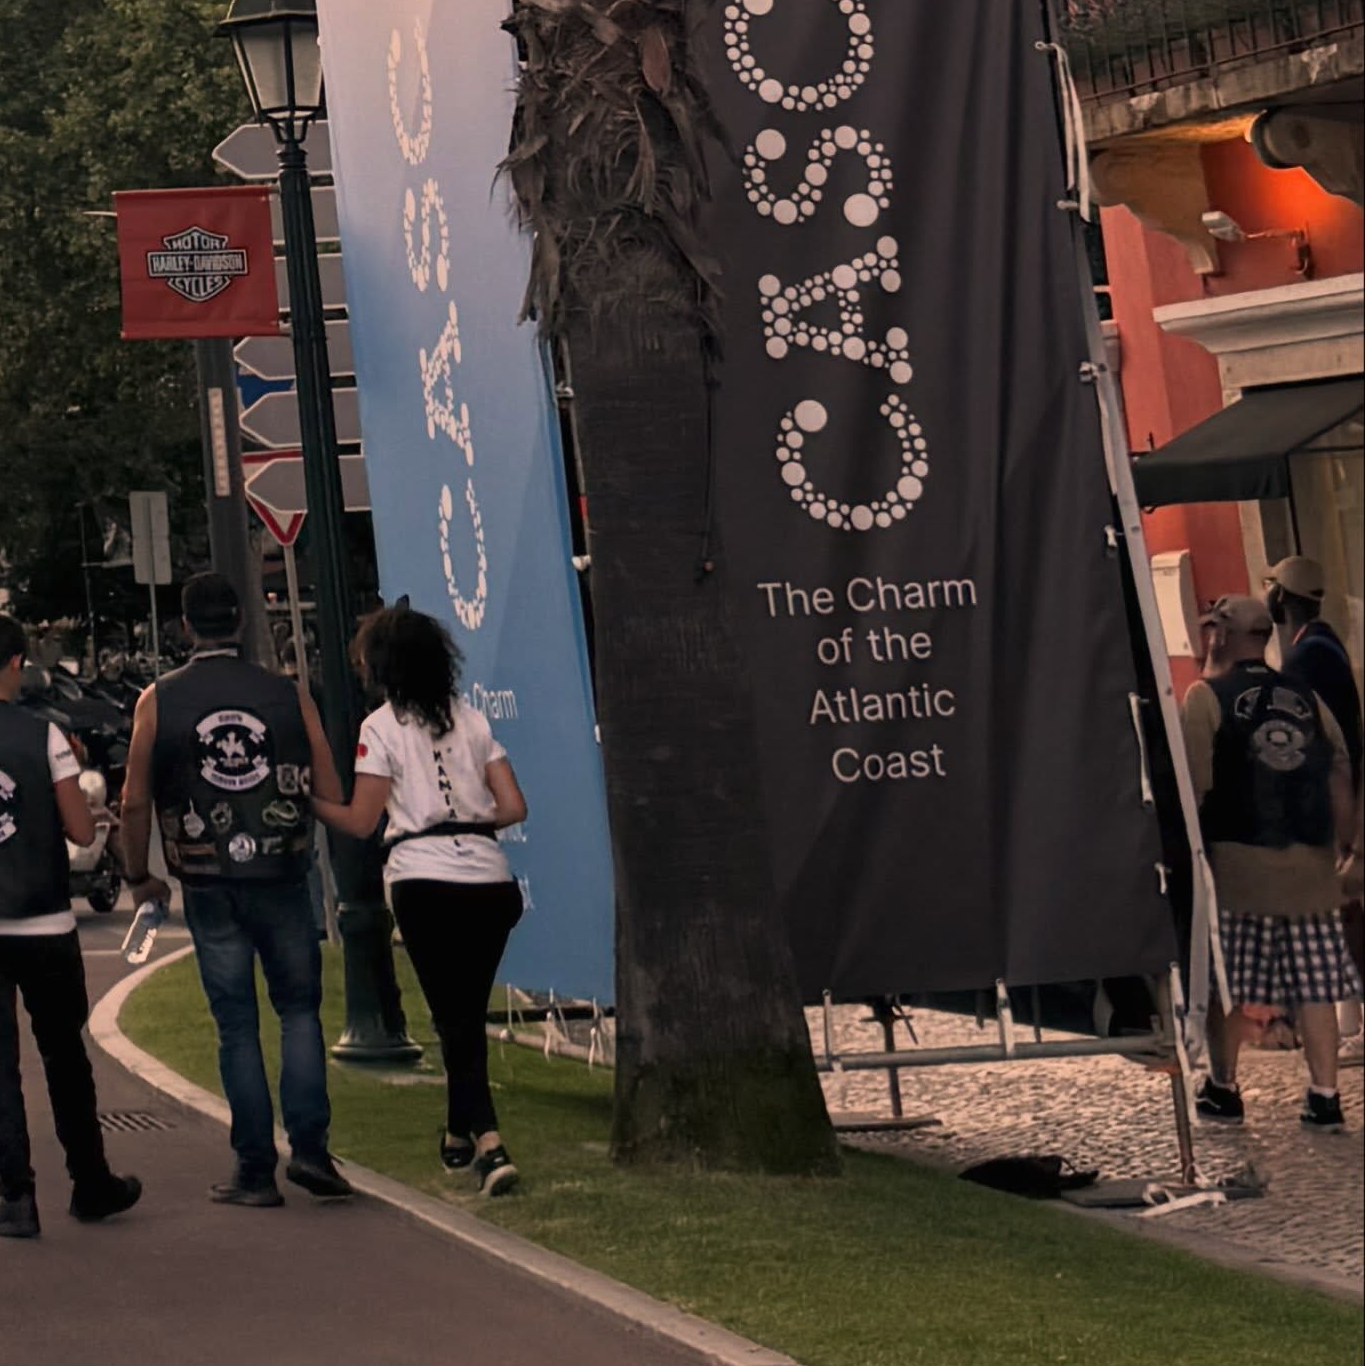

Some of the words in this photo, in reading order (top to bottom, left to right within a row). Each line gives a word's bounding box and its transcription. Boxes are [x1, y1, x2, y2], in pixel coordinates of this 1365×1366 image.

[172, 232, 220, 249] MOTOR
[152, 254, 242, 272] HARLEY-DAVIDSON
[175, 276, 223, 296] CYCLES
[758, 581, 834, 618] The
[846, 576, 976, 614] Charm
[817, 629, 853, 665] of
[867, 627, 932, 661] the
[809, 683, 956, 725] Atlantic
[832, 745, 945, 783] Coast
